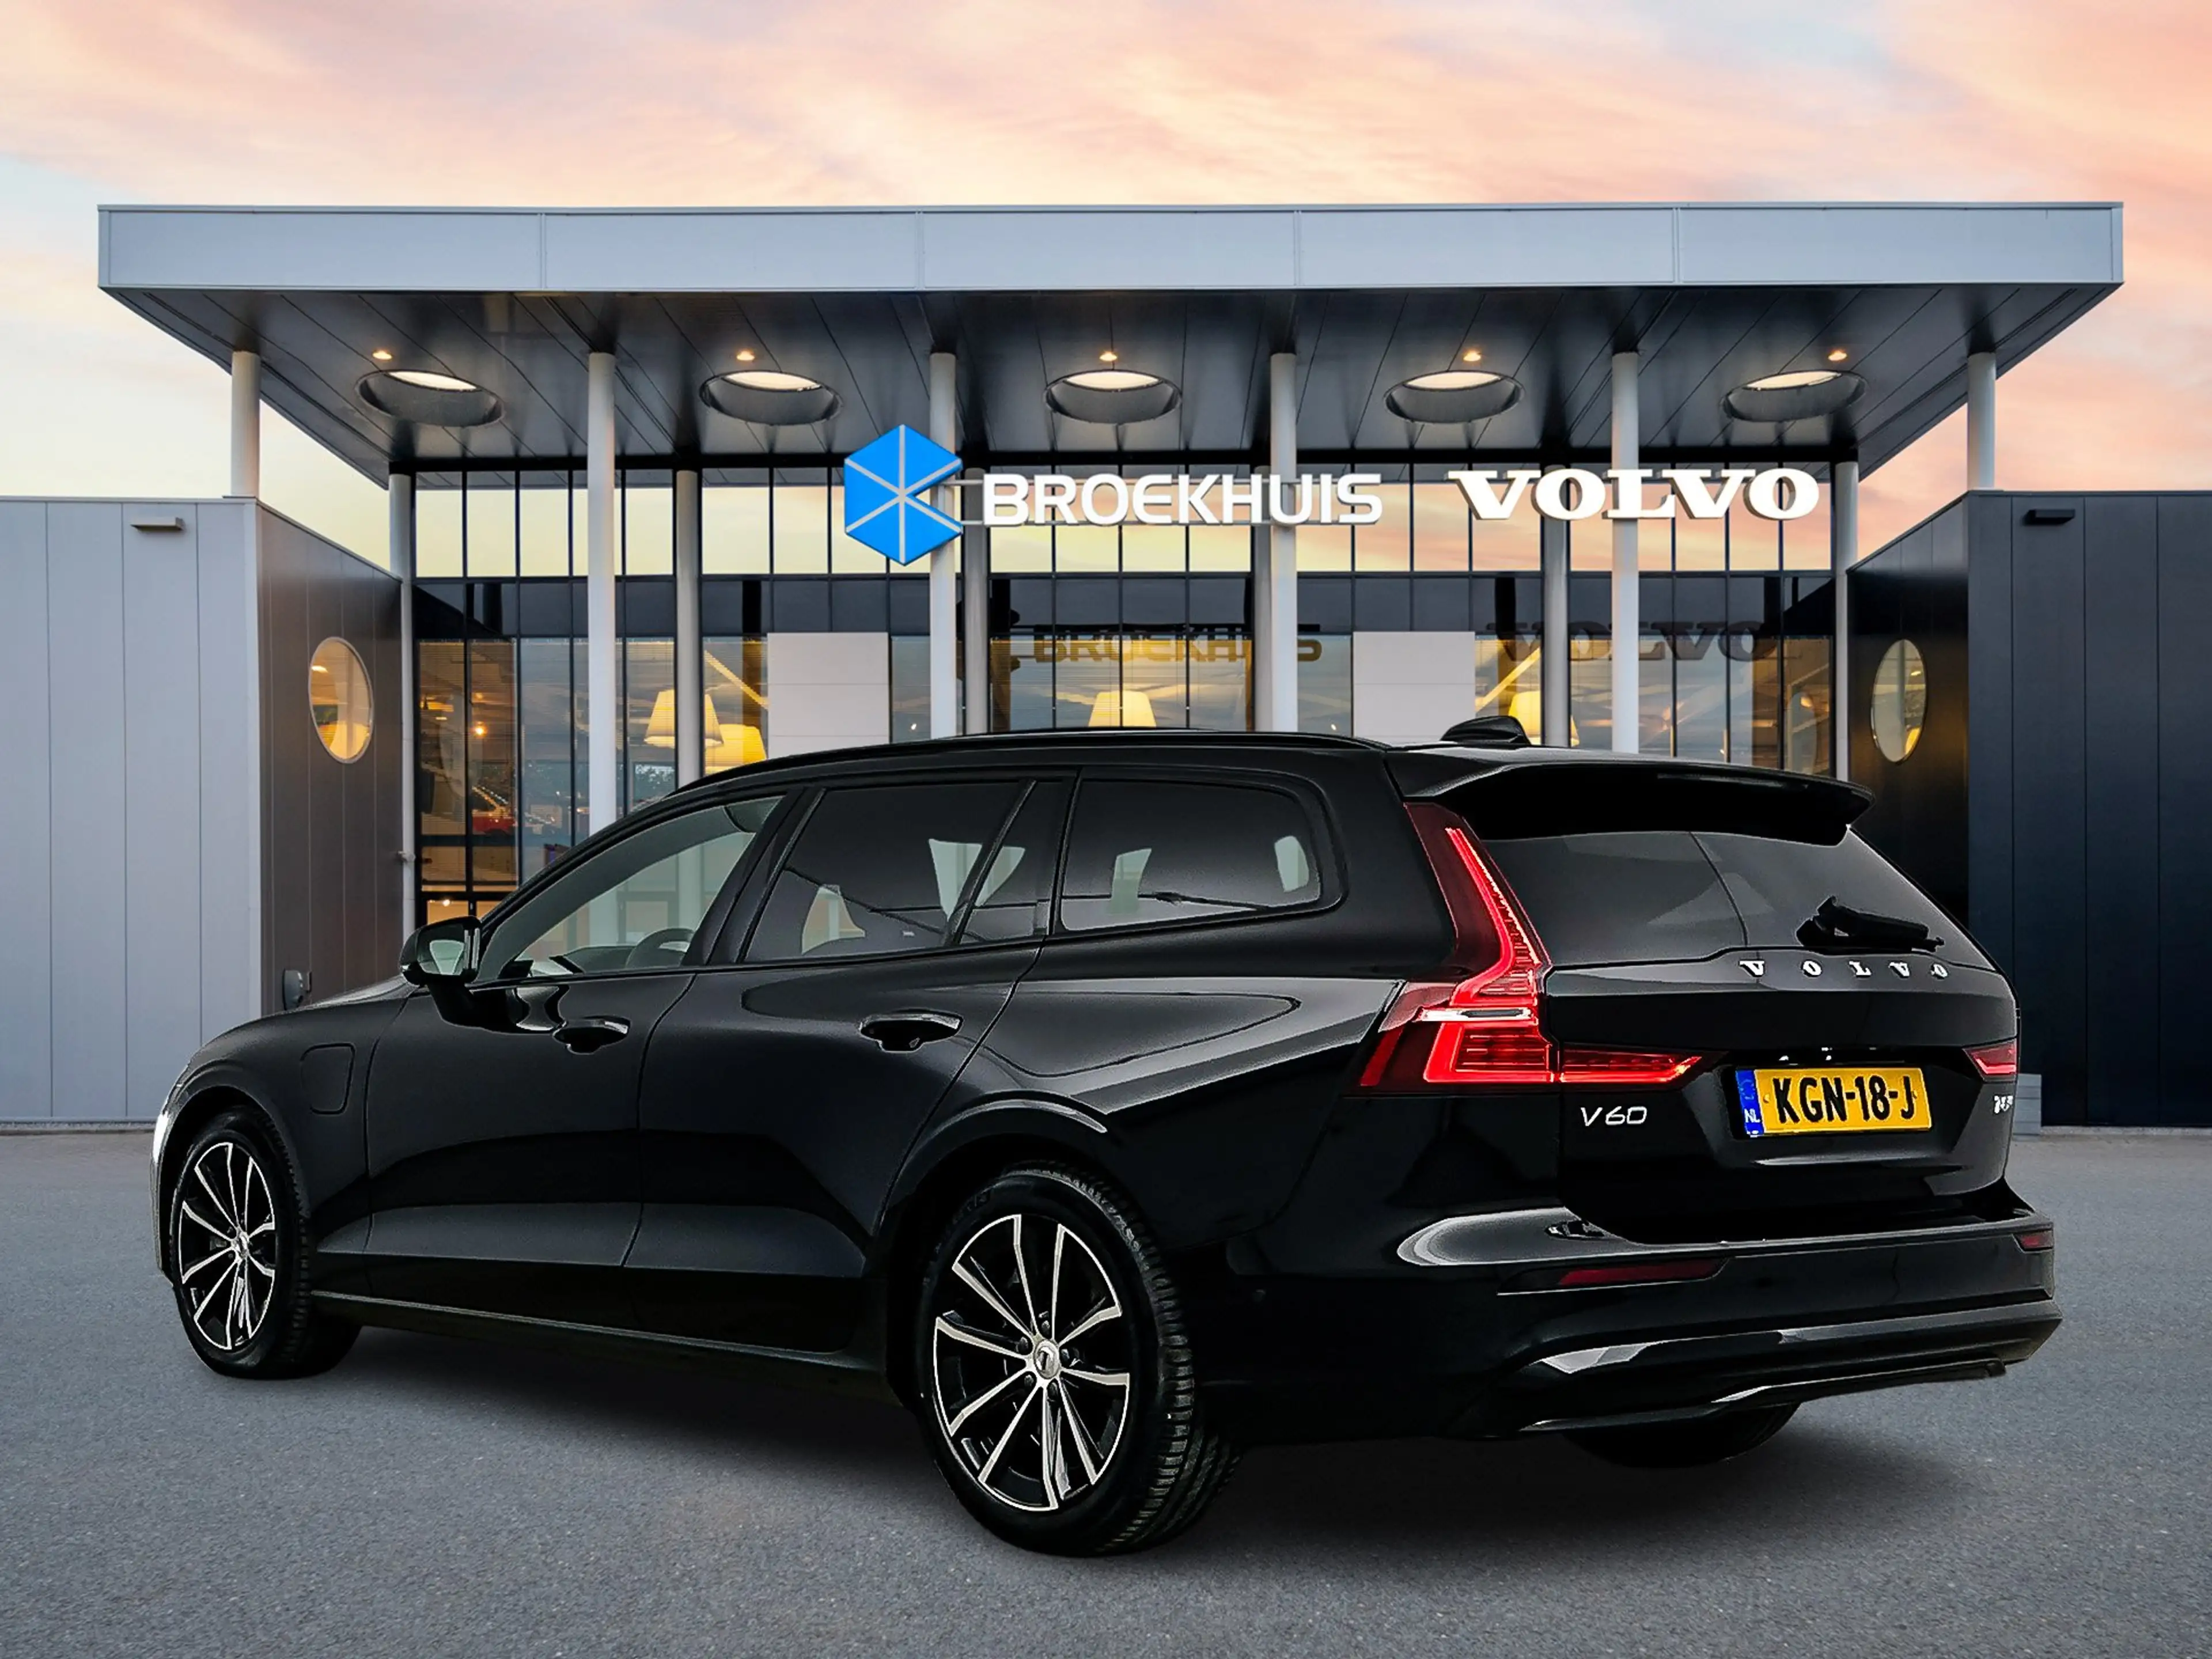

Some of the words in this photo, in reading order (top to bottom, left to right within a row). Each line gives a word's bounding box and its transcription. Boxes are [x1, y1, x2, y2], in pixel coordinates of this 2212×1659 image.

[983, 473, 1383, 527] BROEKHUIS
[1444, 468, 1820, 521] VOLVO
[1738, 959, 1949, 979] VOLVO
[1580, 1105, 1648, 1127] V60
[1744, 1108, 1761, 1123] NL
[1772, 1074, 1915, 1124] KGN-18-J
